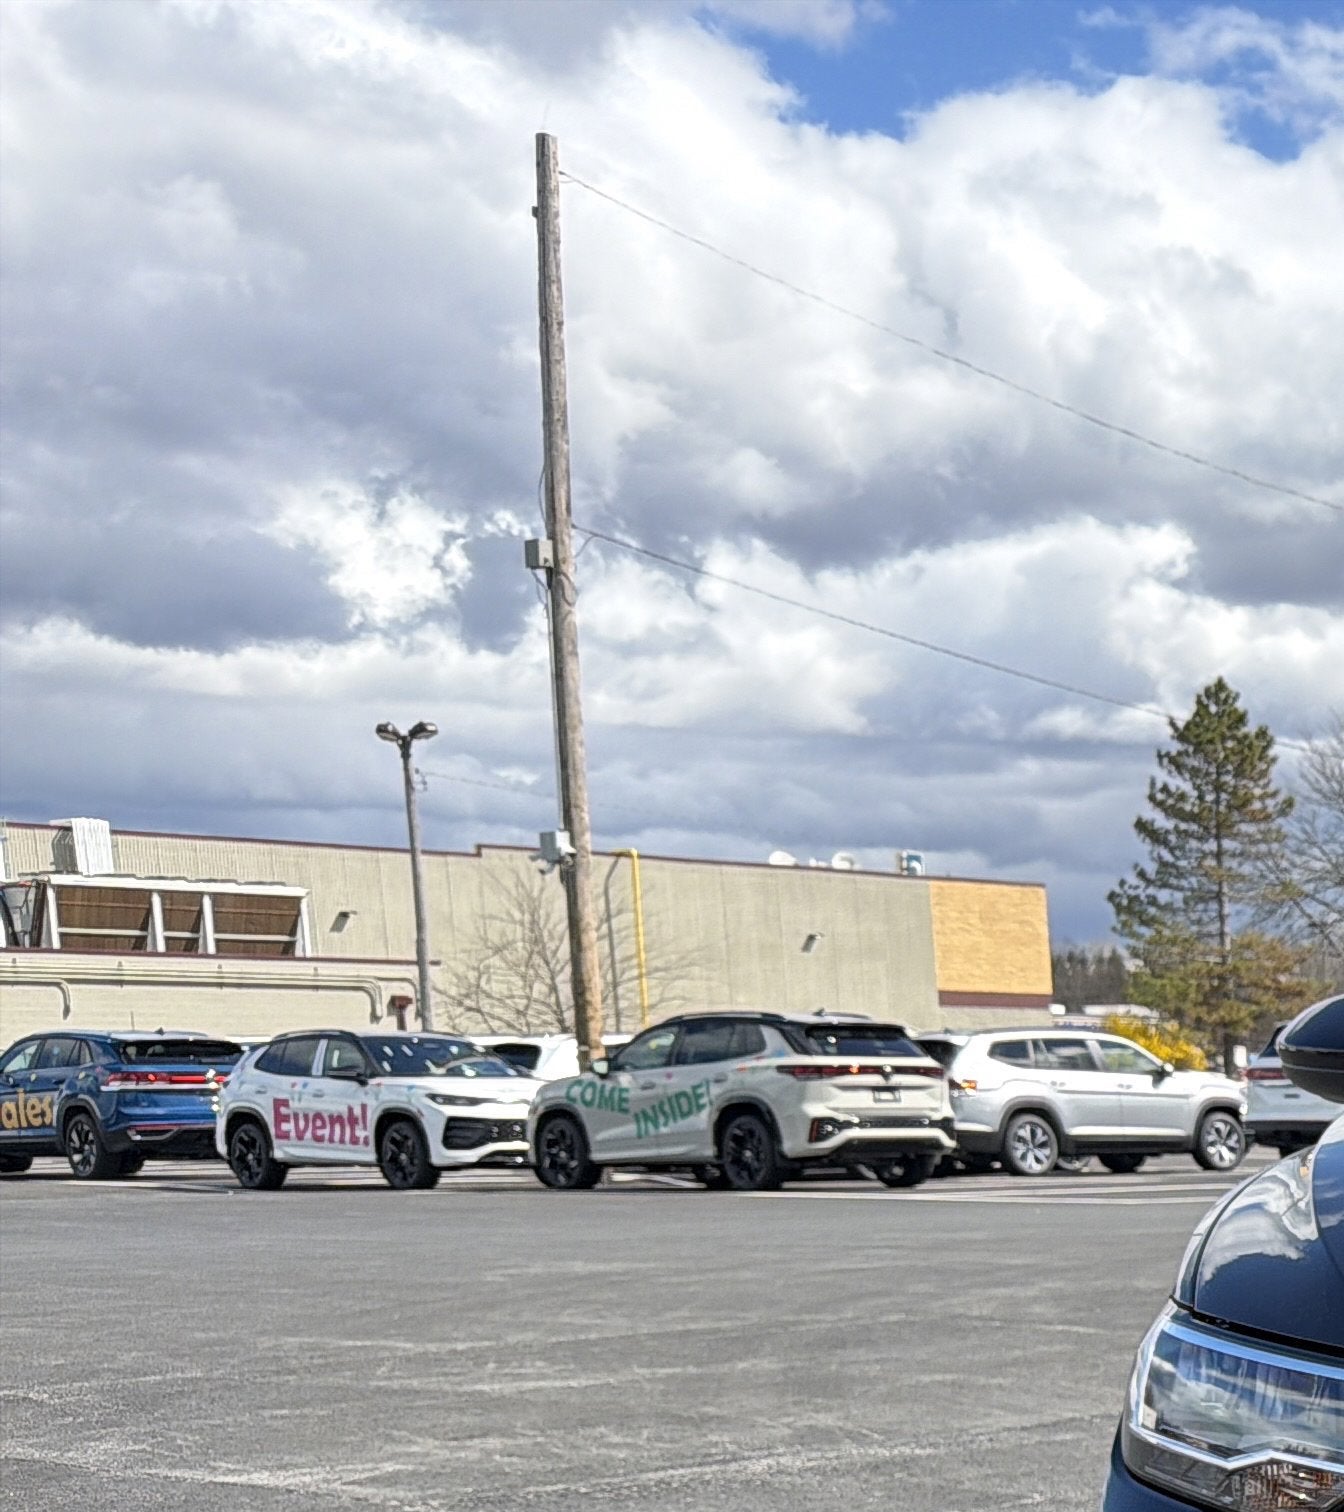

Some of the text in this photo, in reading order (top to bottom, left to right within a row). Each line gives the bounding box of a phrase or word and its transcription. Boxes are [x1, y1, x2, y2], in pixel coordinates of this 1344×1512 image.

[566, 1079, 631, 1114] COME
[634, 1079, 713, 1139] INSIDE!
[273, 1098, 369, 1147] Event!
